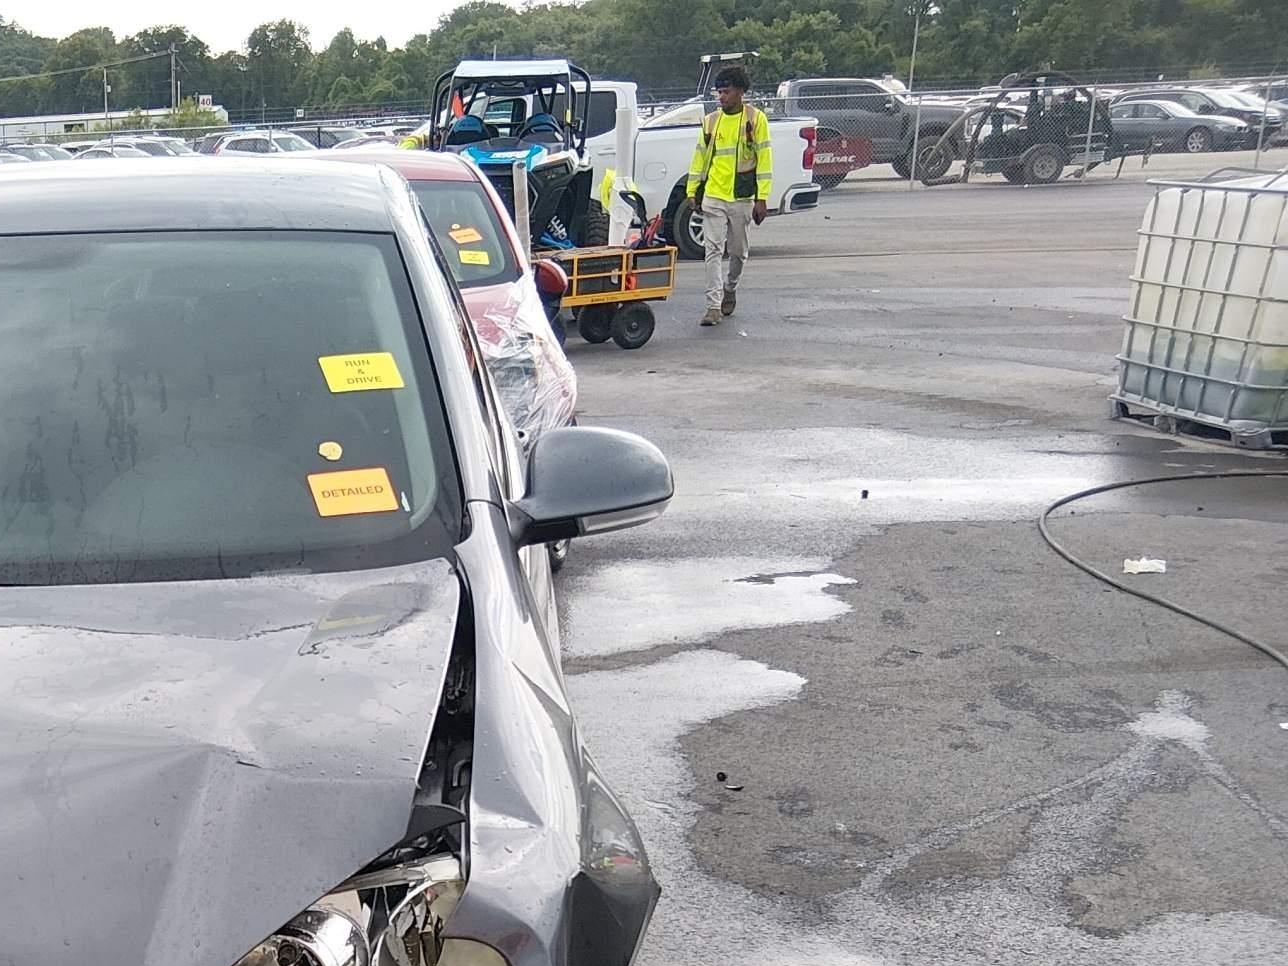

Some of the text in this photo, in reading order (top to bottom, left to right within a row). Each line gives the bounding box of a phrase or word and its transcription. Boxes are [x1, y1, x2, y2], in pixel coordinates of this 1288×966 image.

[344, 359, 371, 368] RUN
[345, 375, 384, 385] DRIVE
[321, 485, 384, 499] DETAILED
